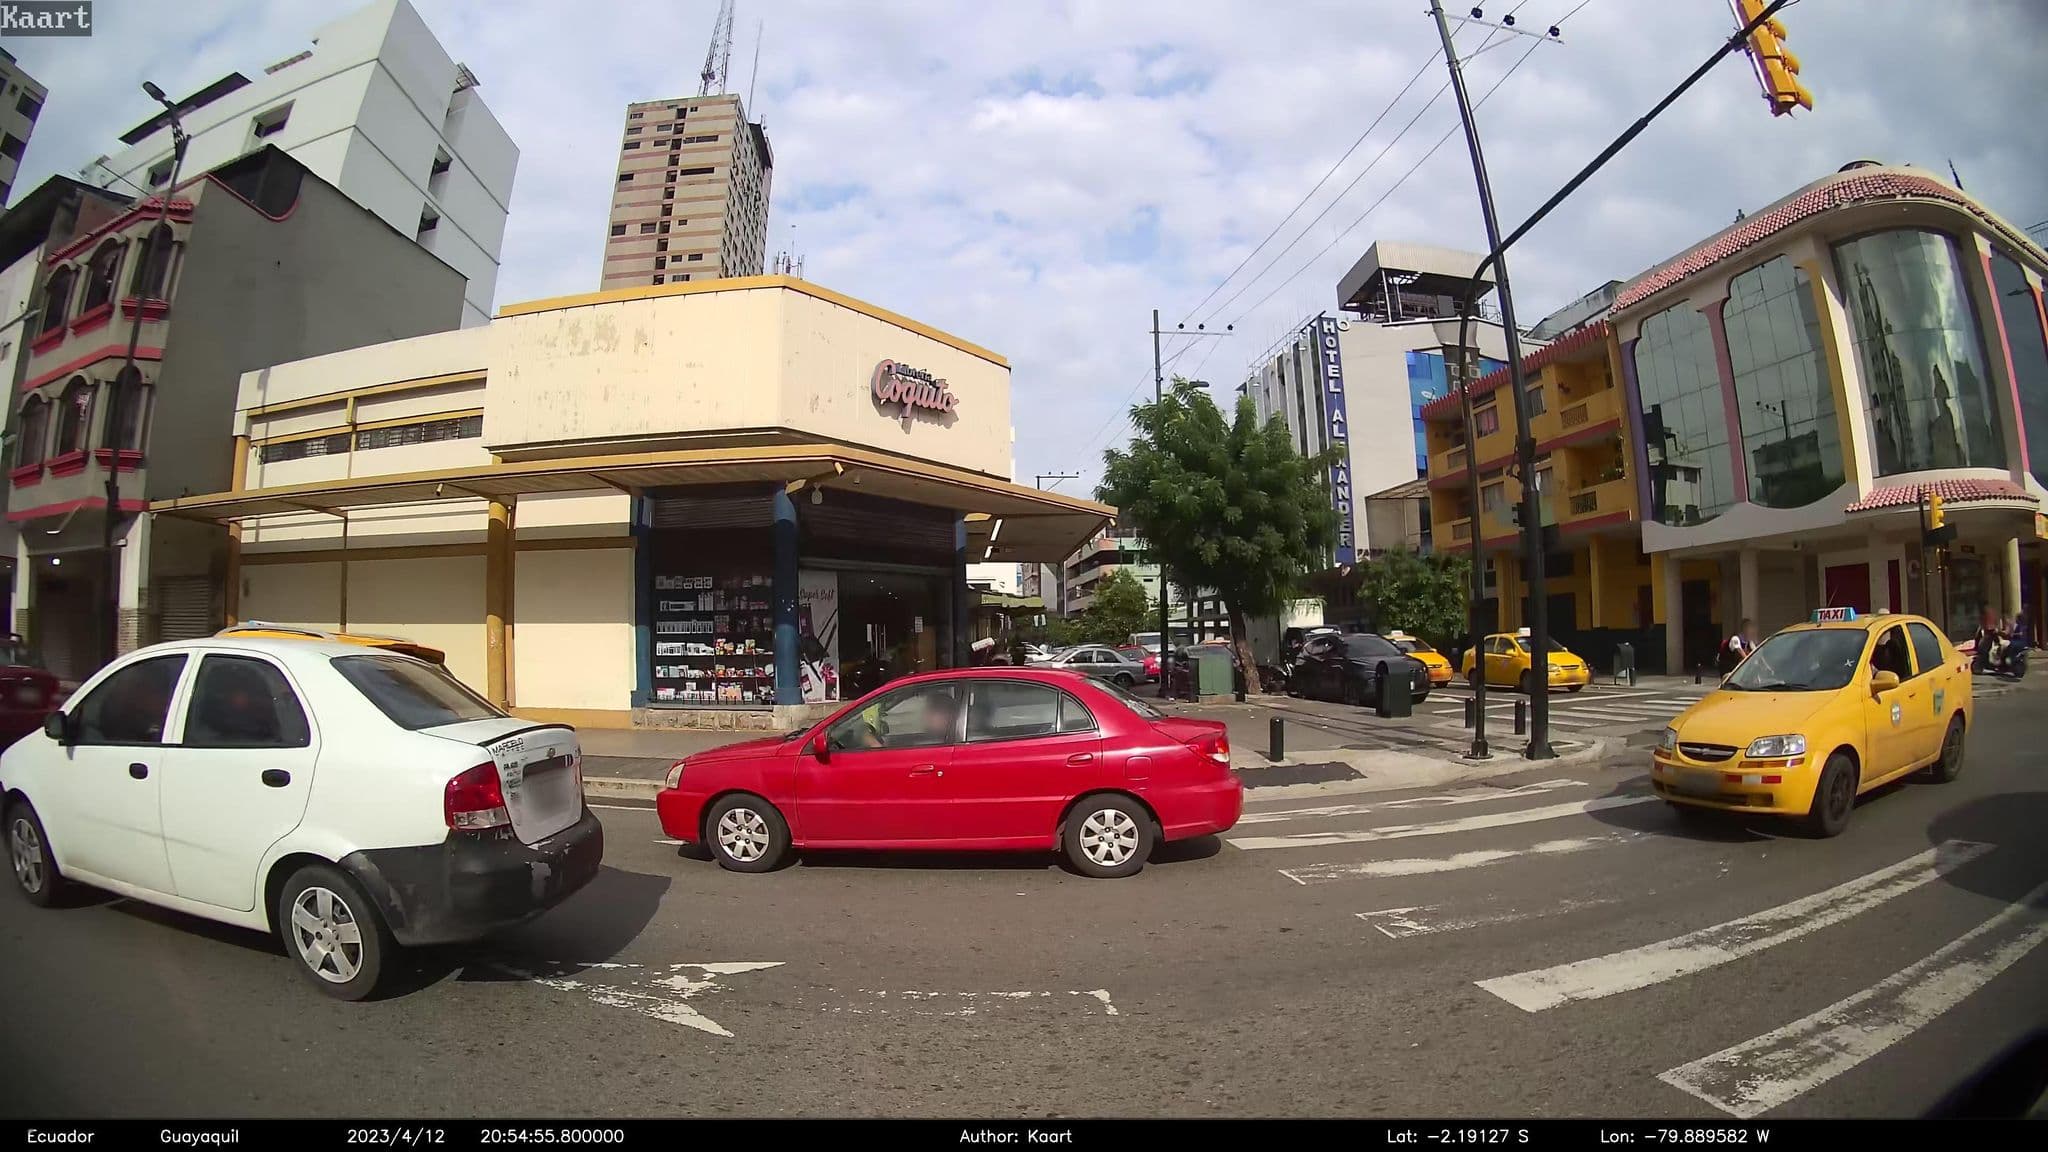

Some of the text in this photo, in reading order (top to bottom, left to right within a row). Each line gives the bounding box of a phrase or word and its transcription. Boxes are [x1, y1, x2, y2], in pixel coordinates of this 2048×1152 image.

[1323, 320, 1341, 393] HOTEL
[875, 359, 959, 418] Coquito
[1819, 609, 1844, 620] TAXI
